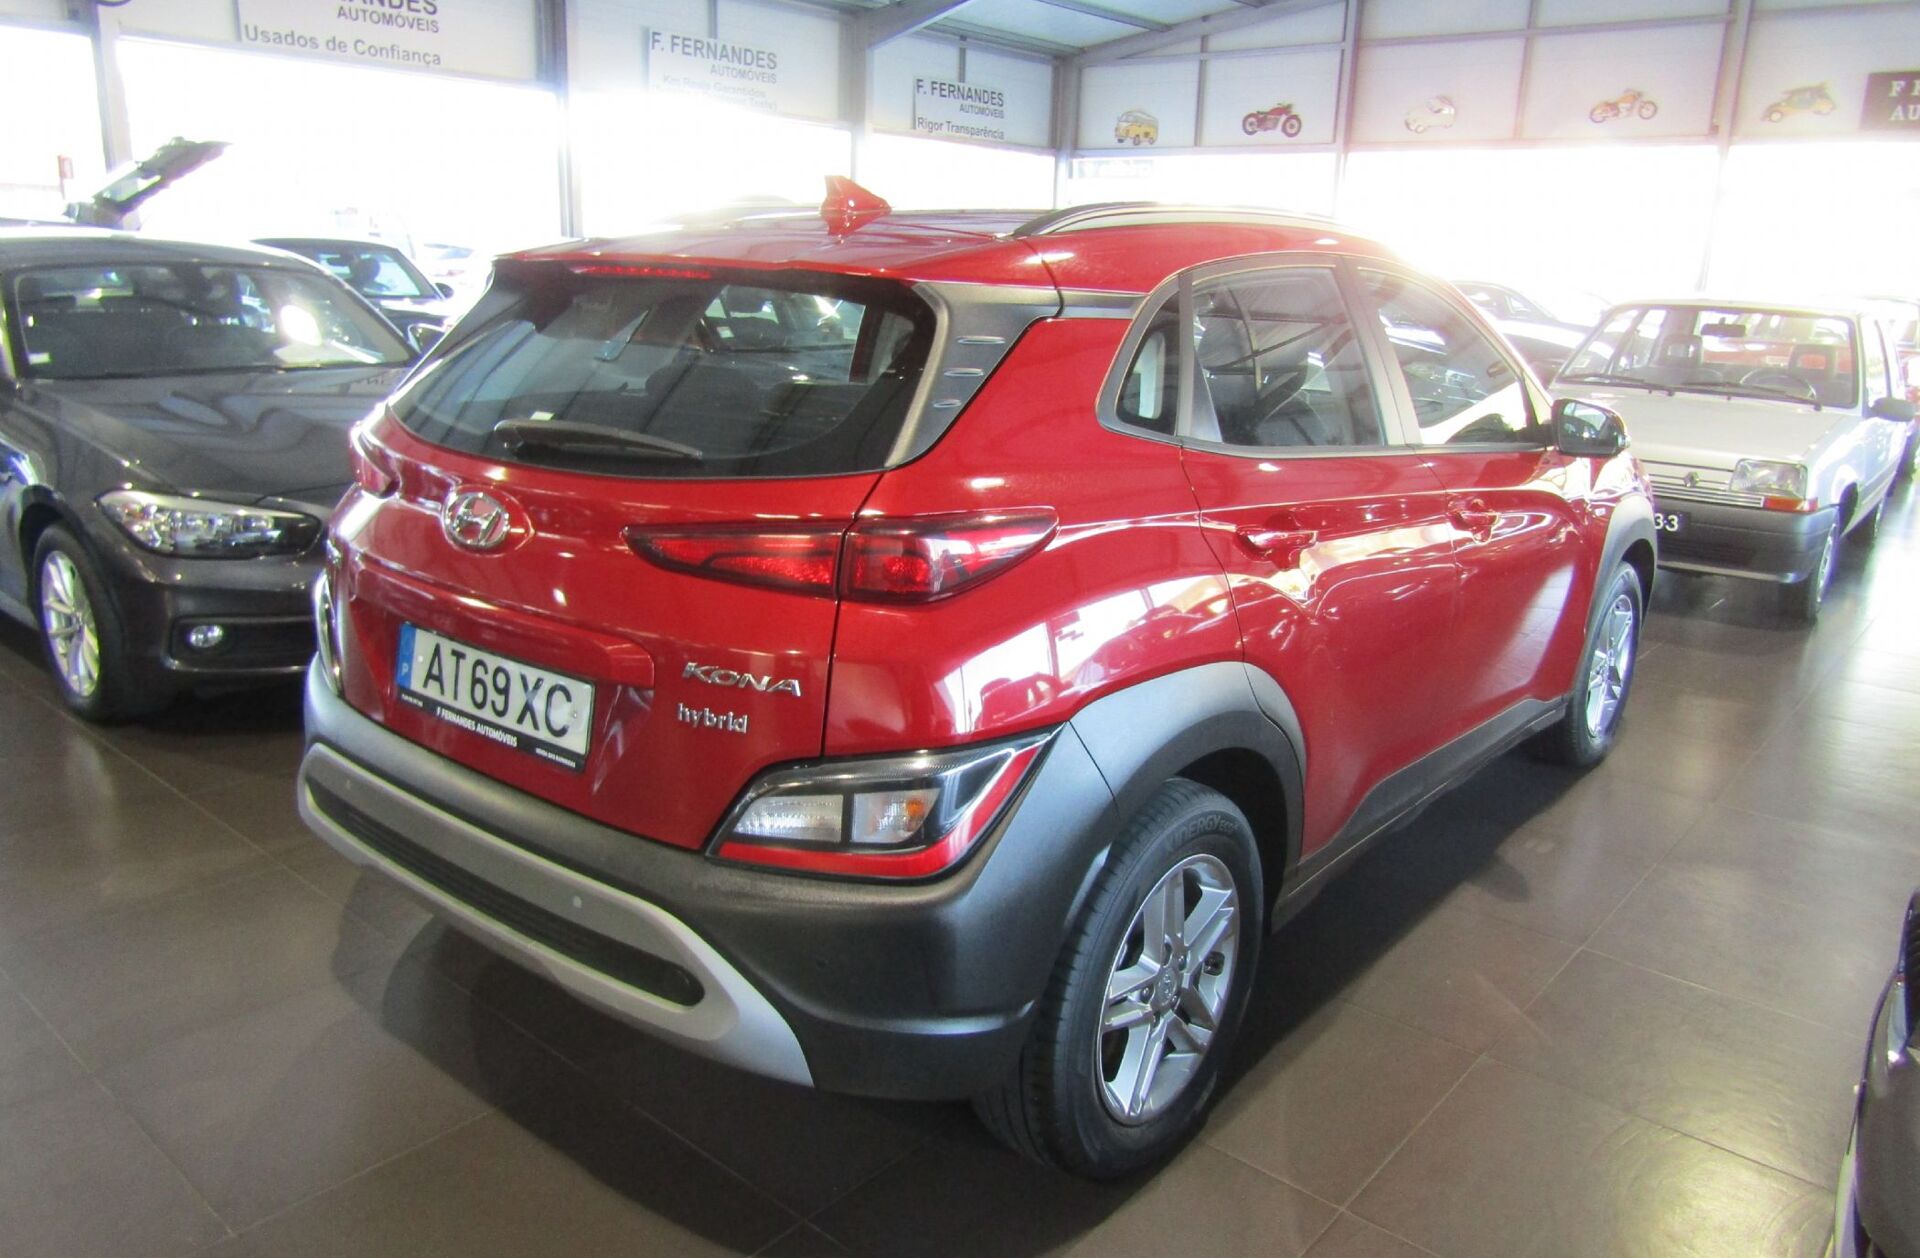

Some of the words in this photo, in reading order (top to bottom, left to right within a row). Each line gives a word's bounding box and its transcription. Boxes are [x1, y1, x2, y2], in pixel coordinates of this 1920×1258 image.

[337, 5, 440, 33] AUTOMÓVEIS
[244, 24, 320, 49] Usados
[325, 36, 348, 53] de
[353, 39, 441, 66] Confiança
[651, 31, 665, 51] F.
[670, 34, 778, 70] FERNANDES
[916, 79, 927, 95] F.
[931, 81, 1004, 107] FERNANDES
[917, 117, 943, 134] Rigor
[682, 661, 802, 697] KONA
[441, 708, 477, 732] FERNANDES
[475, 722, 518, 748] AUTOMÓVEIS
[678, 702, 748, 734] hybrid
